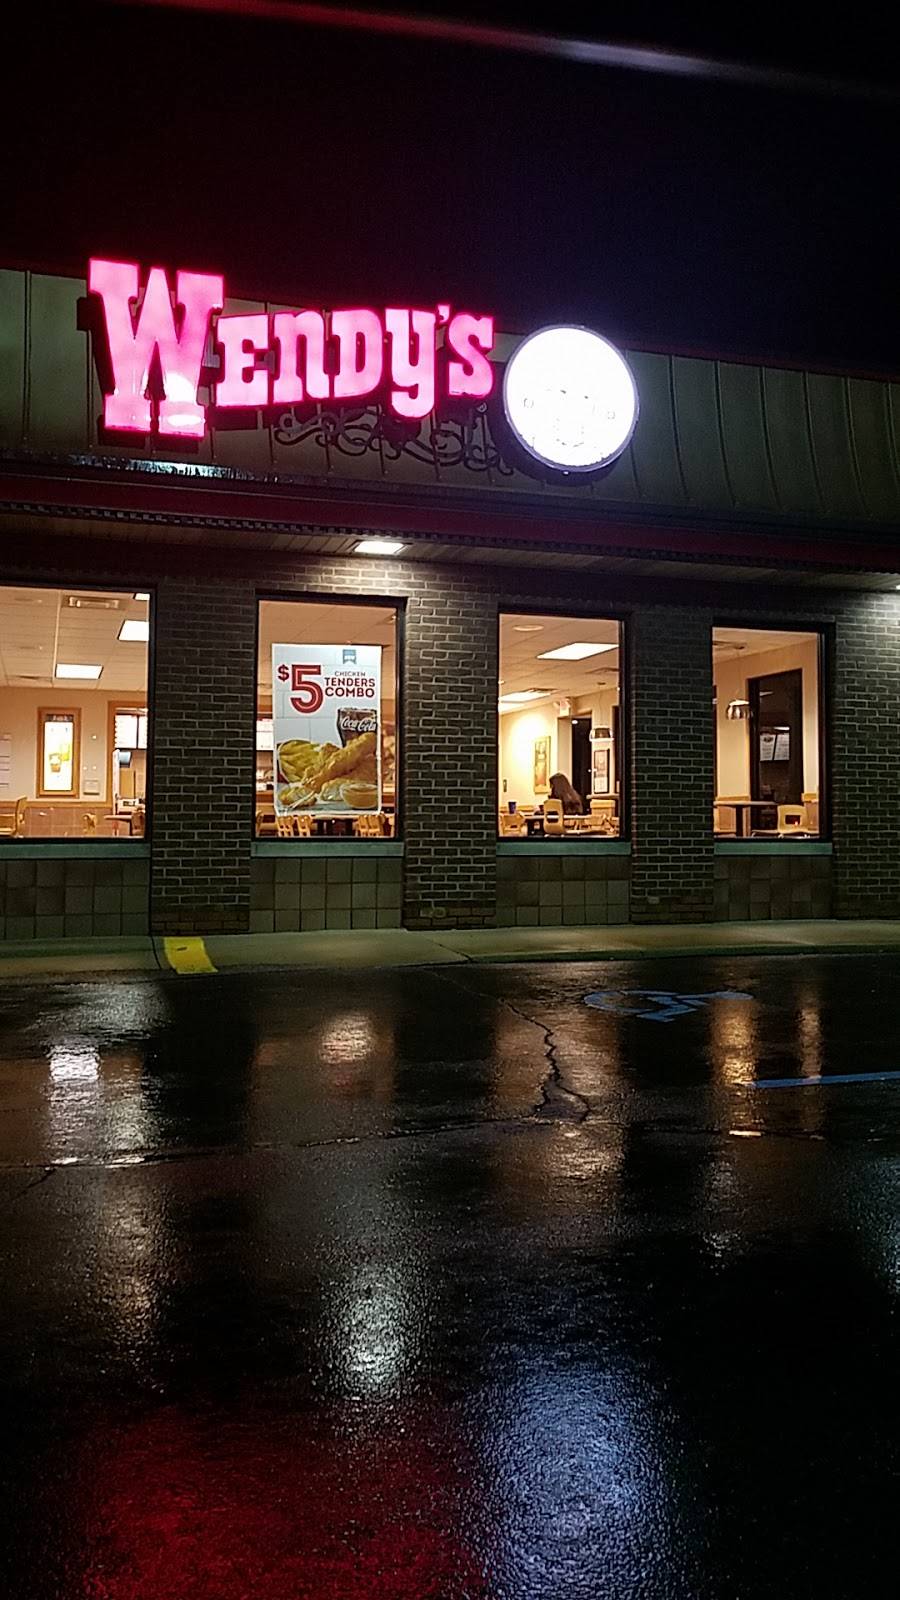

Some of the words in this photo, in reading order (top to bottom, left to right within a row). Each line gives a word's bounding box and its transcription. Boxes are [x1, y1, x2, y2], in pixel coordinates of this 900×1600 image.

[324, 677, 376, 687] TENDERS
[277, 664, 324, 714] $5
[324, 687, 375, 698] COMBO
